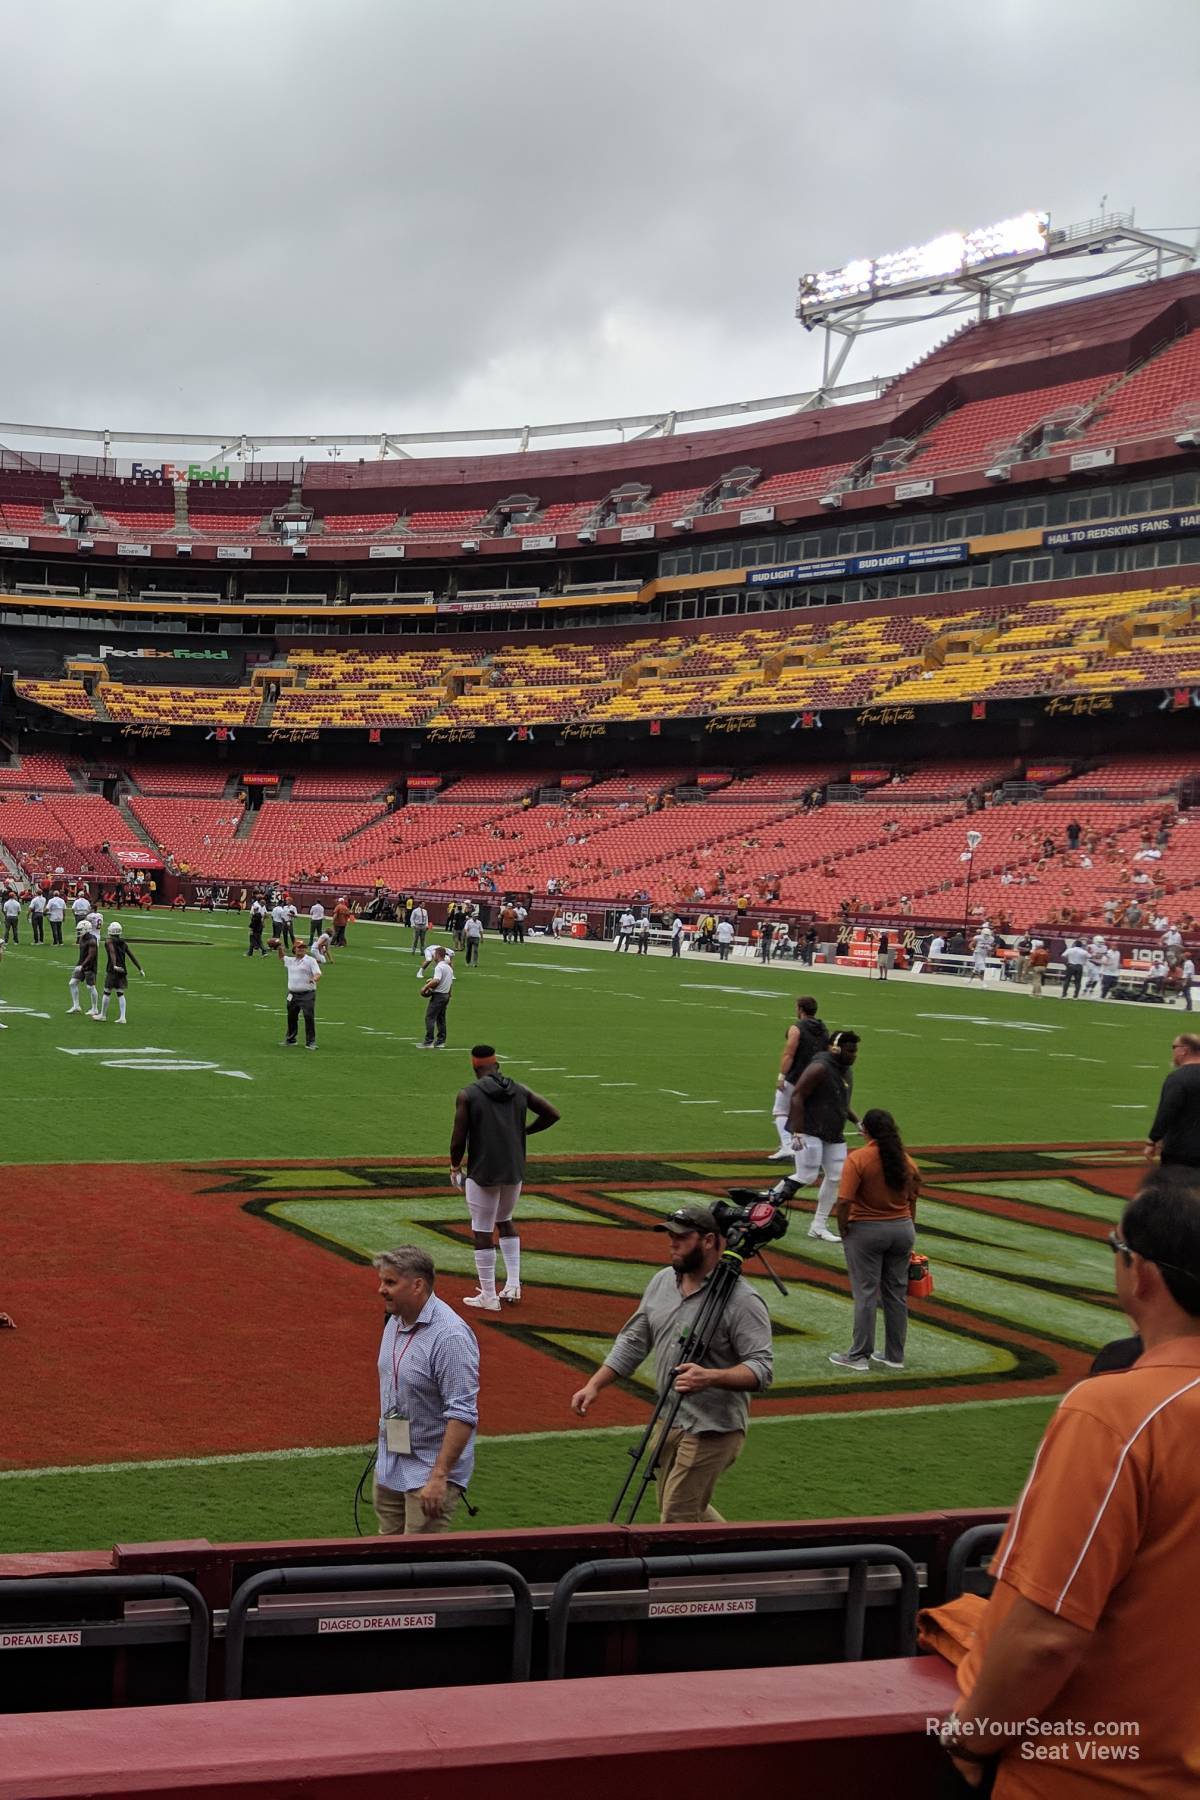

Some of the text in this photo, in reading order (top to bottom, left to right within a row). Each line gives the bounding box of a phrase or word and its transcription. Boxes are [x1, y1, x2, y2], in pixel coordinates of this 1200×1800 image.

[132, 462, 230, 481] FedExField
[1048, 519, 1172, 546] HAIL TO REDSKINS FANS.
[859, 555, 906, 569] BUD LIGHT
[752, 570, 795, 582] BUD LIGHT
[100, 645, 230, 660] FedExField
[758, 922, 788, 934] 172
[650, 1601, 754, 1615] DIAGEO DREAM SEATS
[320, 1616, 434, 1630] DIAGEO DREAM SEATS
[2, 1634, 44, 1647] DREAM
[47, 1632, 79, 1646] SEATS
